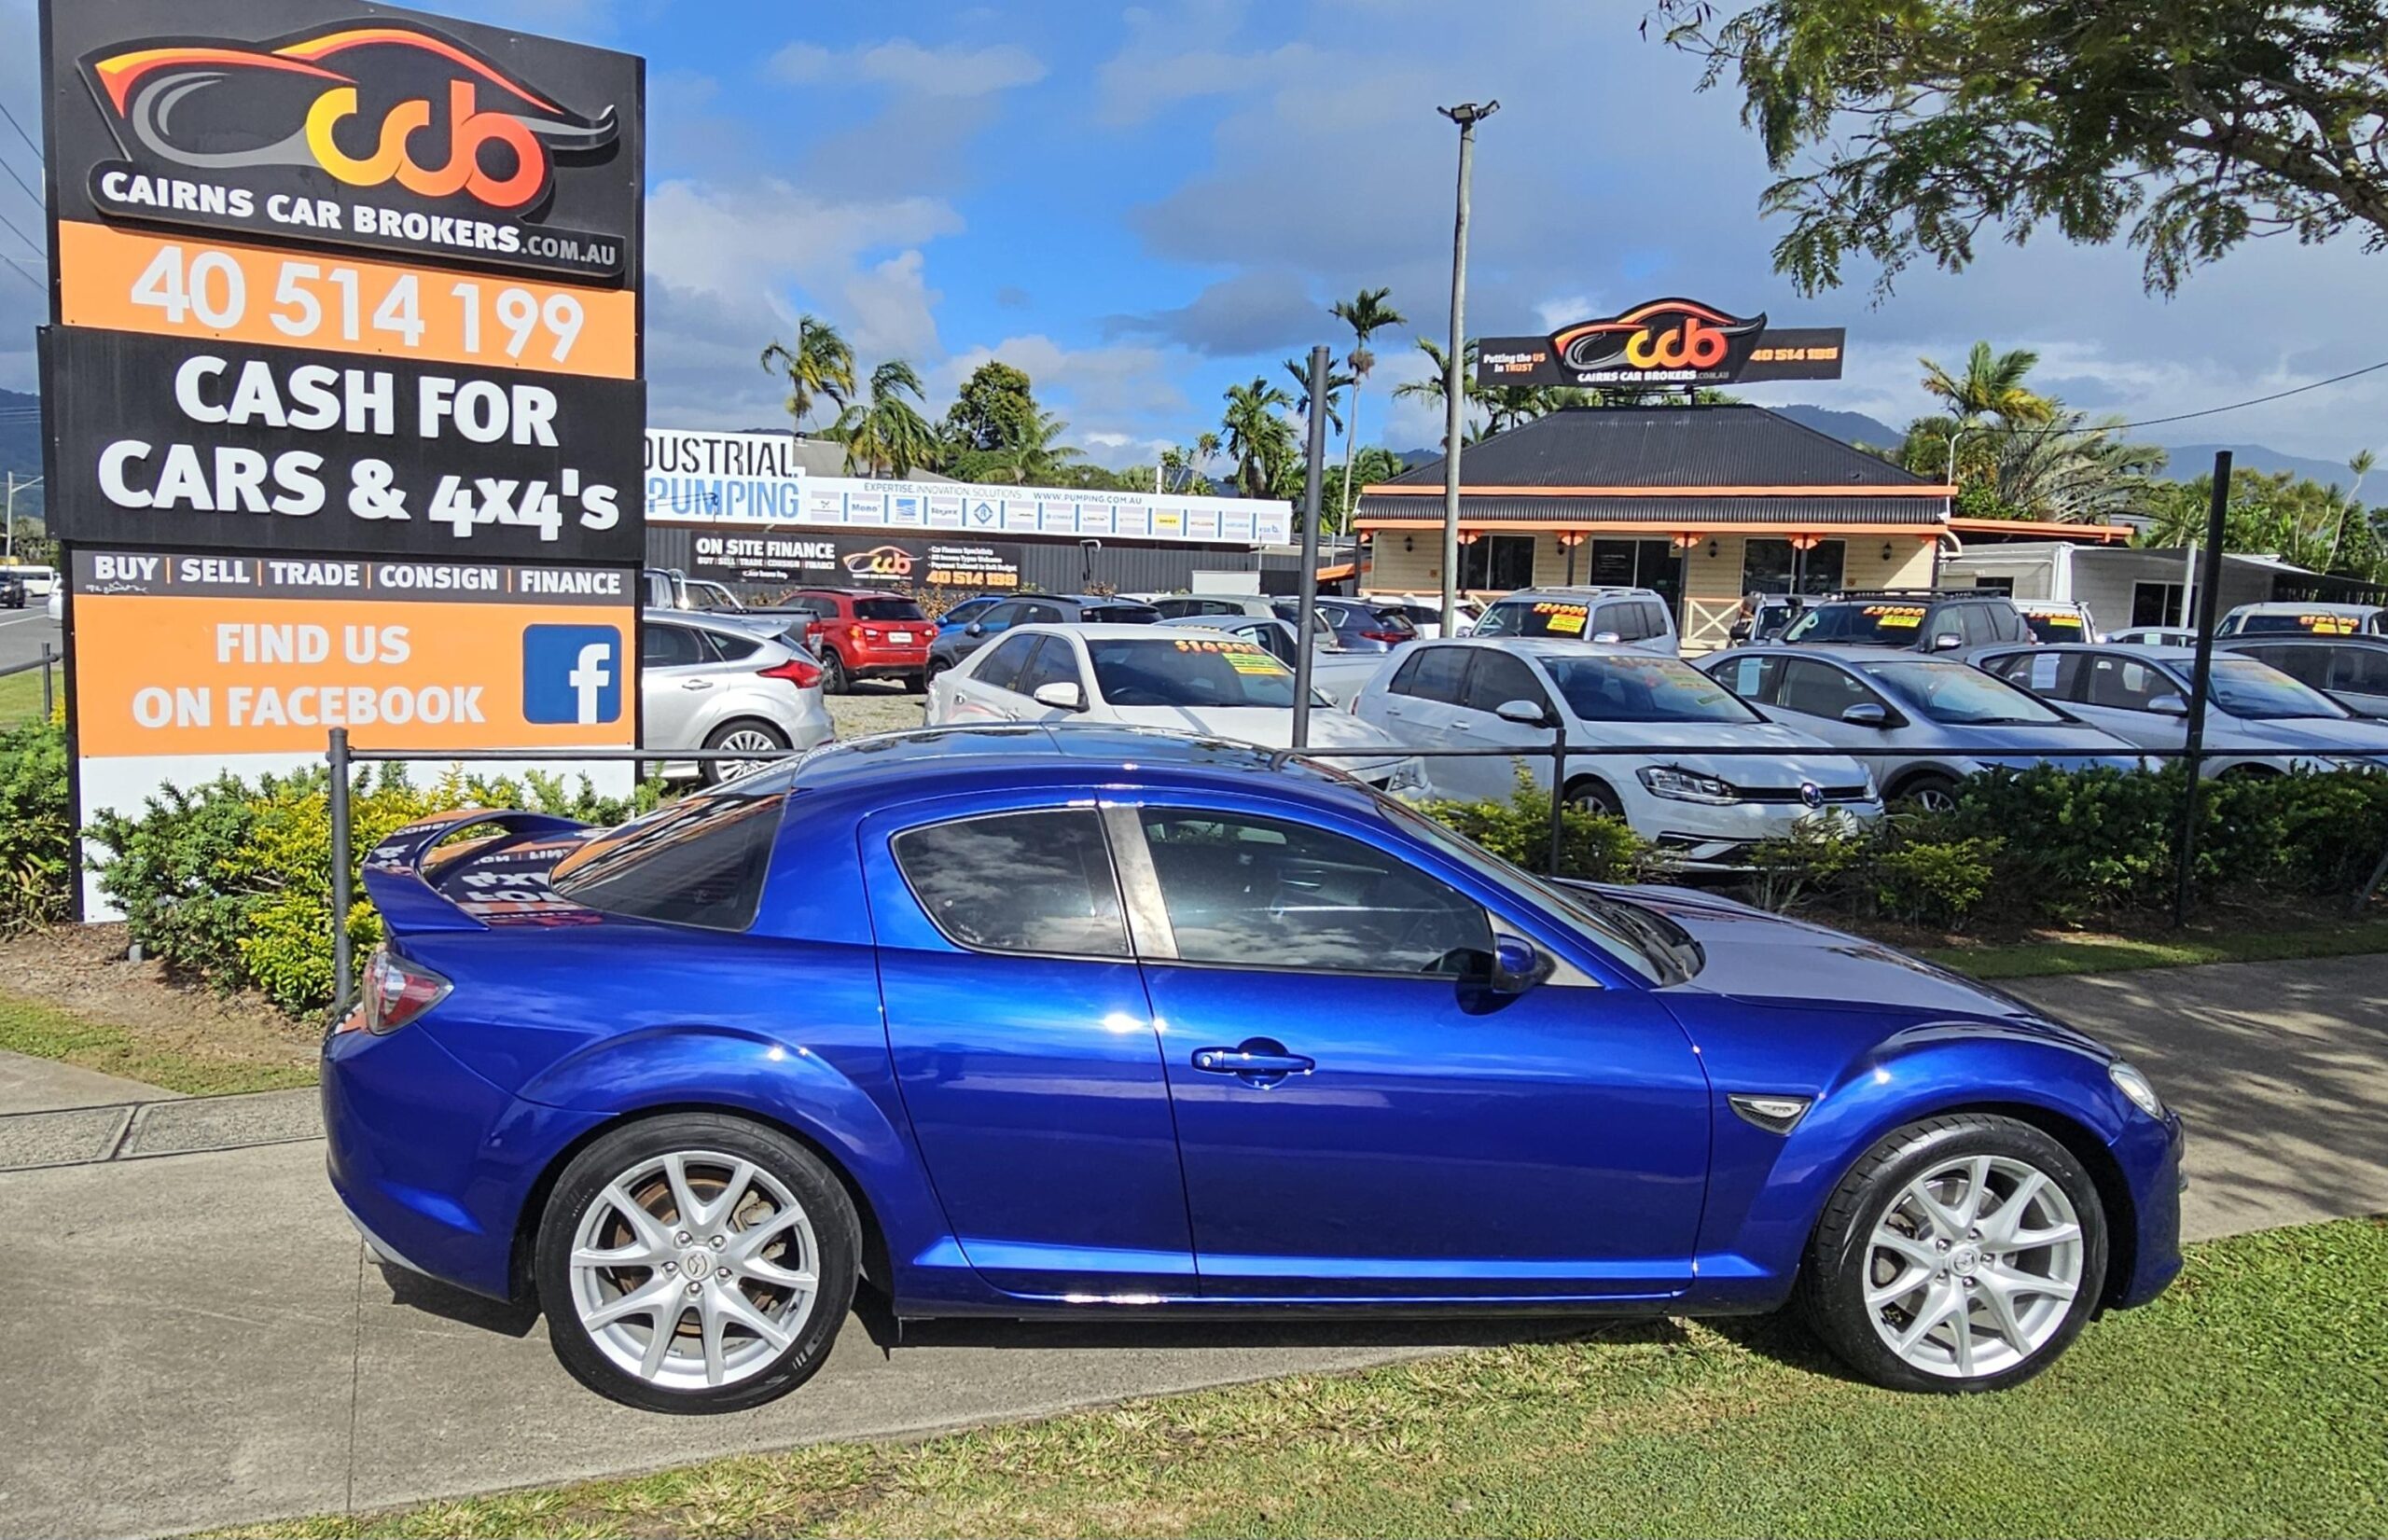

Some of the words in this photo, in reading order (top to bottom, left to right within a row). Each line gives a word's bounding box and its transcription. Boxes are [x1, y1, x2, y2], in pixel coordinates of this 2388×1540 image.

[101, 171, 254, 218] CAIRNS
[266, 194, 341, 230] CAR
[130, 245, 246, 330] 40
[269, 262, 424, 348] 514
[451, 283, 584, 364] 199
[1506, 363, 1534, 372] TRUST
[1533, 353, 1546, 362] US
[1749, 349, 1773, 360] 40
[1774, 349, 1805, 360] 514
[1577, 372, 1618, 382] CAIRNS
[1619, 372, 1643, 382] CAR
[174, 355, 394, 435] CASH
[418, 376, 559, 447] FOR
[98, 439, 326, 516] CARS
[348, 459, 410, 520] &
[648, 478, 799, 518] PUMPING
[696, 537, 723, 554] ON
[726, 539, 764, 556] SITE
[767, 541, 835, 559] FINANCE
[740, 558, 763, 566] TRADE
[95, 556, 158, 581] BUY
[181, 558, 250, 585] SELL
[270, 562, 359, 588] TRADE
[380, 564, 497, 591] CONSIGN
[521, 570, 620, 595] FINANCE
[926, 570, 951, 584] 40
[951, 571, 984, 585] 514
[216, 623, 329, 664] FIND
[345, 625, 410, 664] US
[132, 687, 210, 728] ON
[229, 687, 485, 727] FACEBOOK
